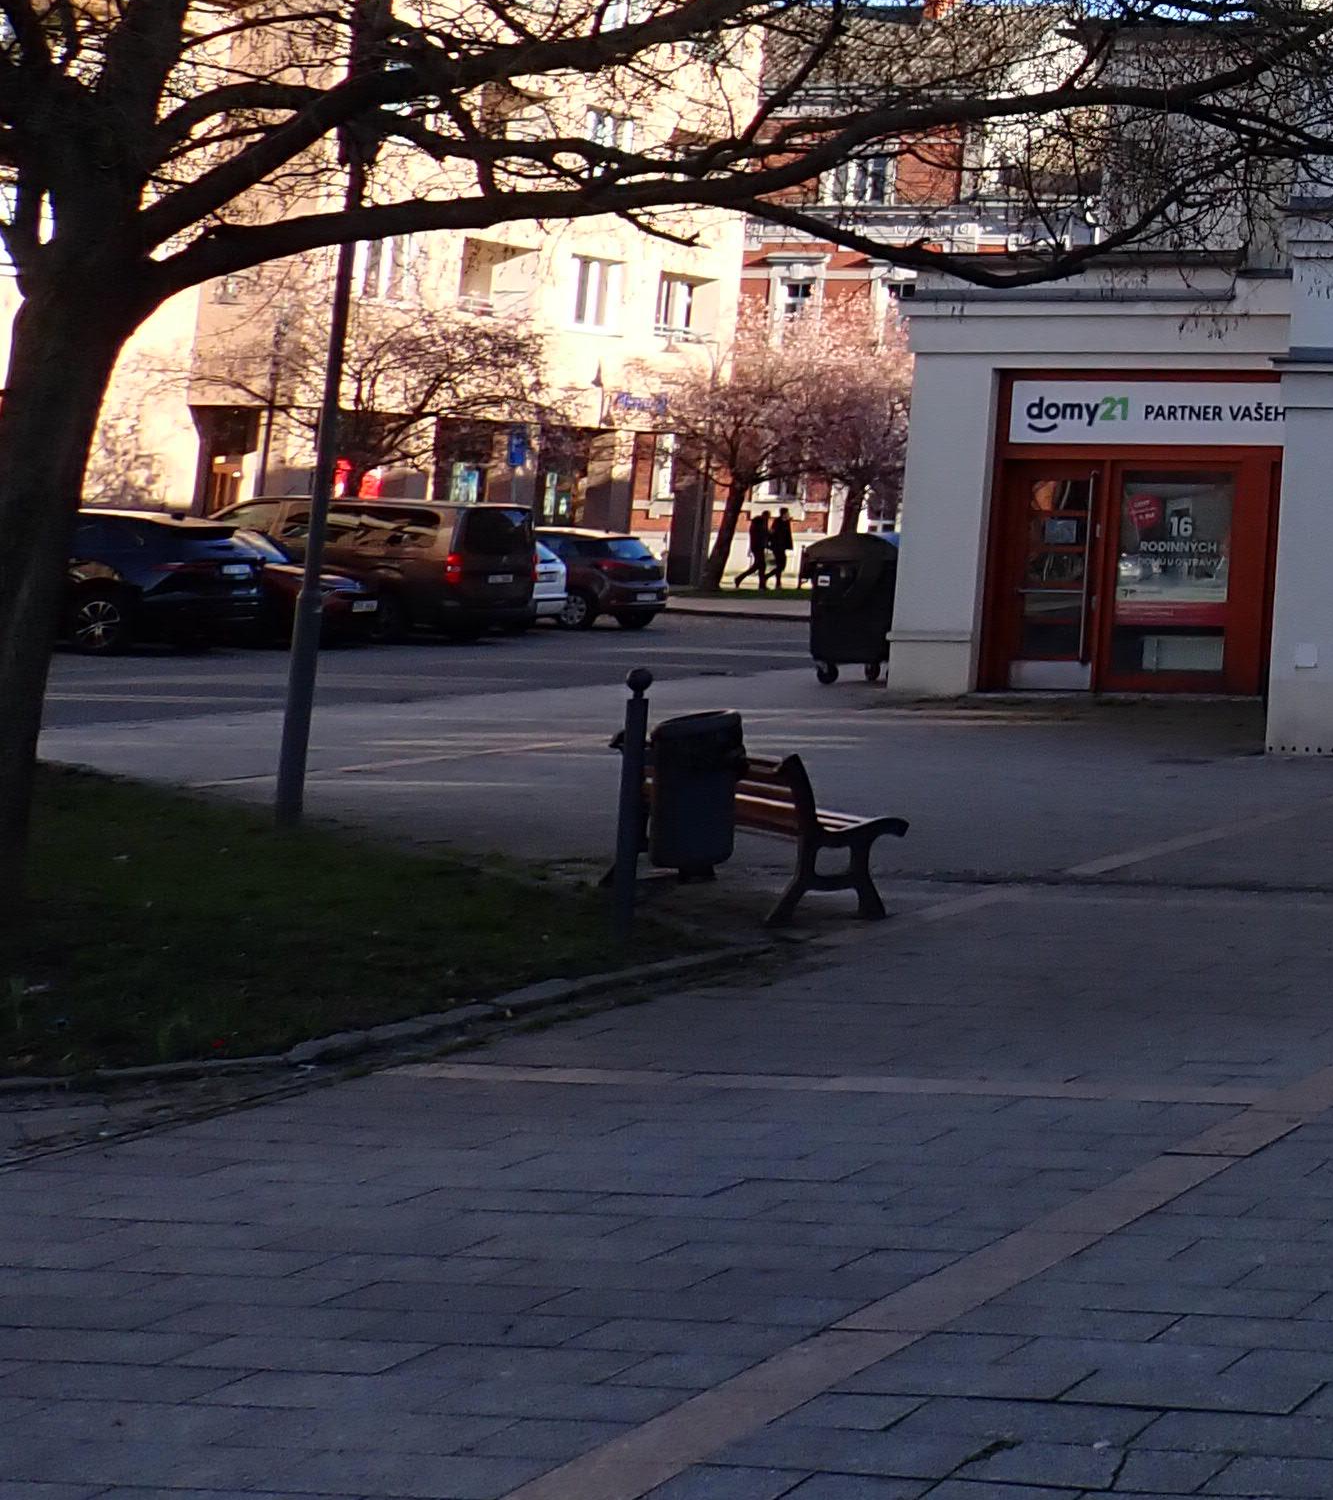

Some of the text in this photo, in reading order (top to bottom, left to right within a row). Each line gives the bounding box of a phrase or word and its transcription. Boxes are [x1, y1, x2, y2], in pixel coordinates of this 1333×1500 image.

[1026, 396, 1129, 427] domy21
[1144, 404, 1222, 421] PARTNER
[1170, 516, 1193, 537] 16
[1140, 539, 1217, 553] RODINNÝCH
